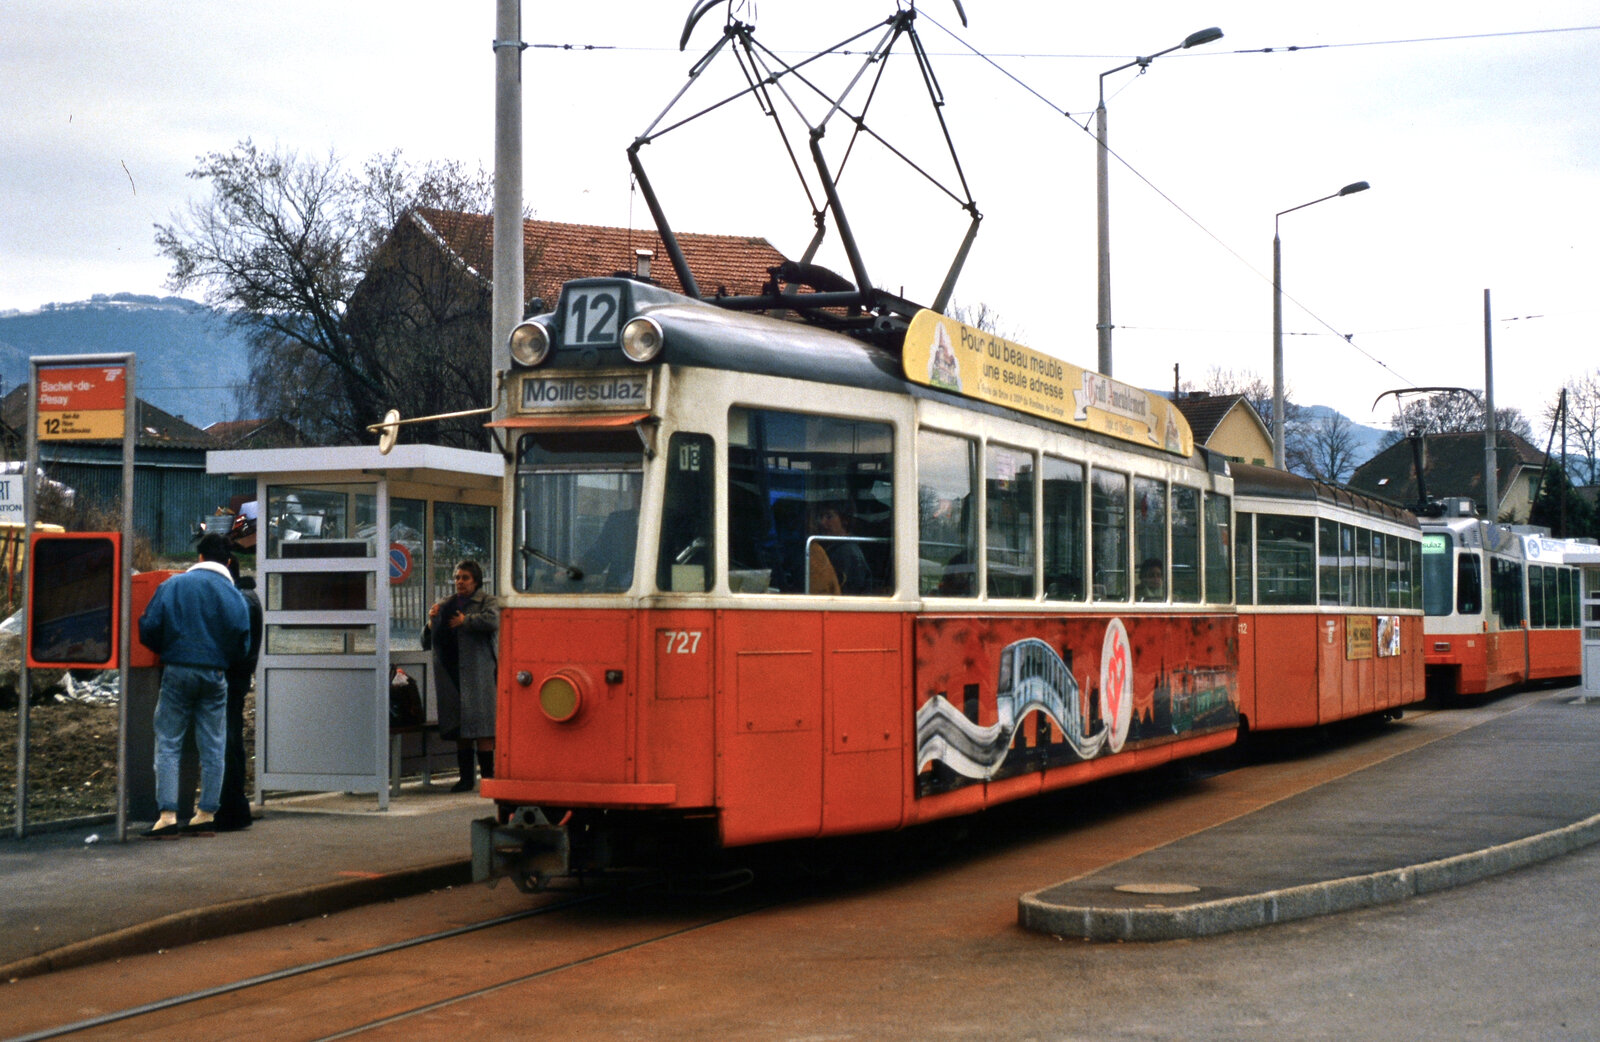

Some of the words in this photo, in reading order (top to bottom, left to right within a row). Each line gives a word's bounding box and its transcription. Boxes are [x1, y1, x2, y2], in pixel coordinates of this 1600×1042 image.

[571, 294, 617, 343] 12
[961, 326, 985, 353] Pour
[988, 337, 1000, 360] du
[1003, 343, 1028, 369] beau
[1030, 356, 1063, 381] meuble
[526, 379, 643, 402] Moillesulaz
[983, 362, 1000, 381] une
[1002, 368, 1028, 389] seule
[1029, 377, 1064, 400] adresse
[44, 418, 60, 434] 12
[665, 632, 702, 654] 727
